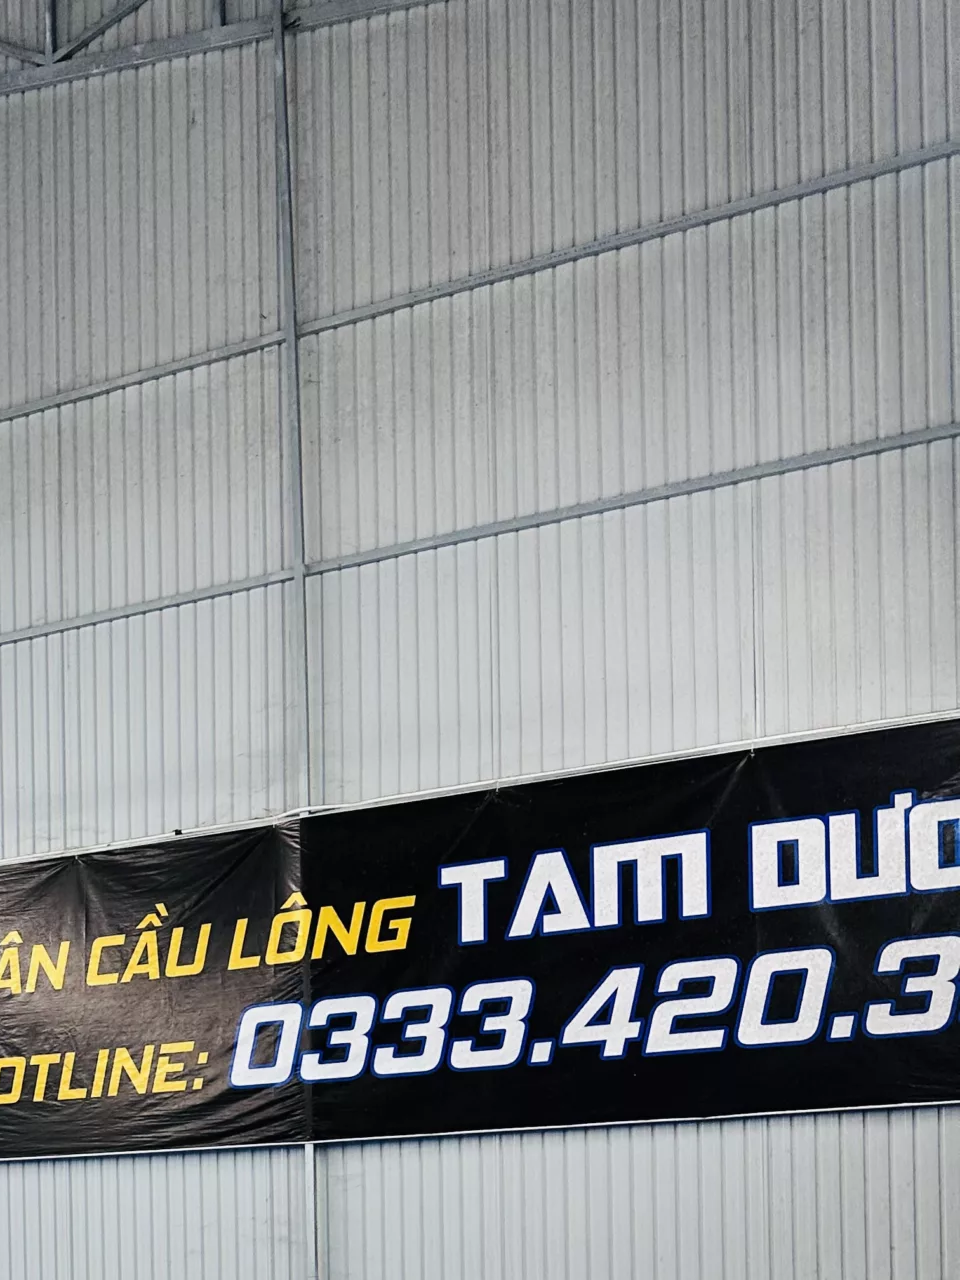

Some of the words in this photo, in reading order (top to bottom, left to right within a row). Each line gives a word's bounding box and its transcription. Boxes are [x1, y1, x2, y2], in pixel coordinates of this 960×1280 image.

[86, 903, 212, 987] CẦU
[227, 892, 417, 971] LÔNG
[439, 829, 711, 945] TAM
